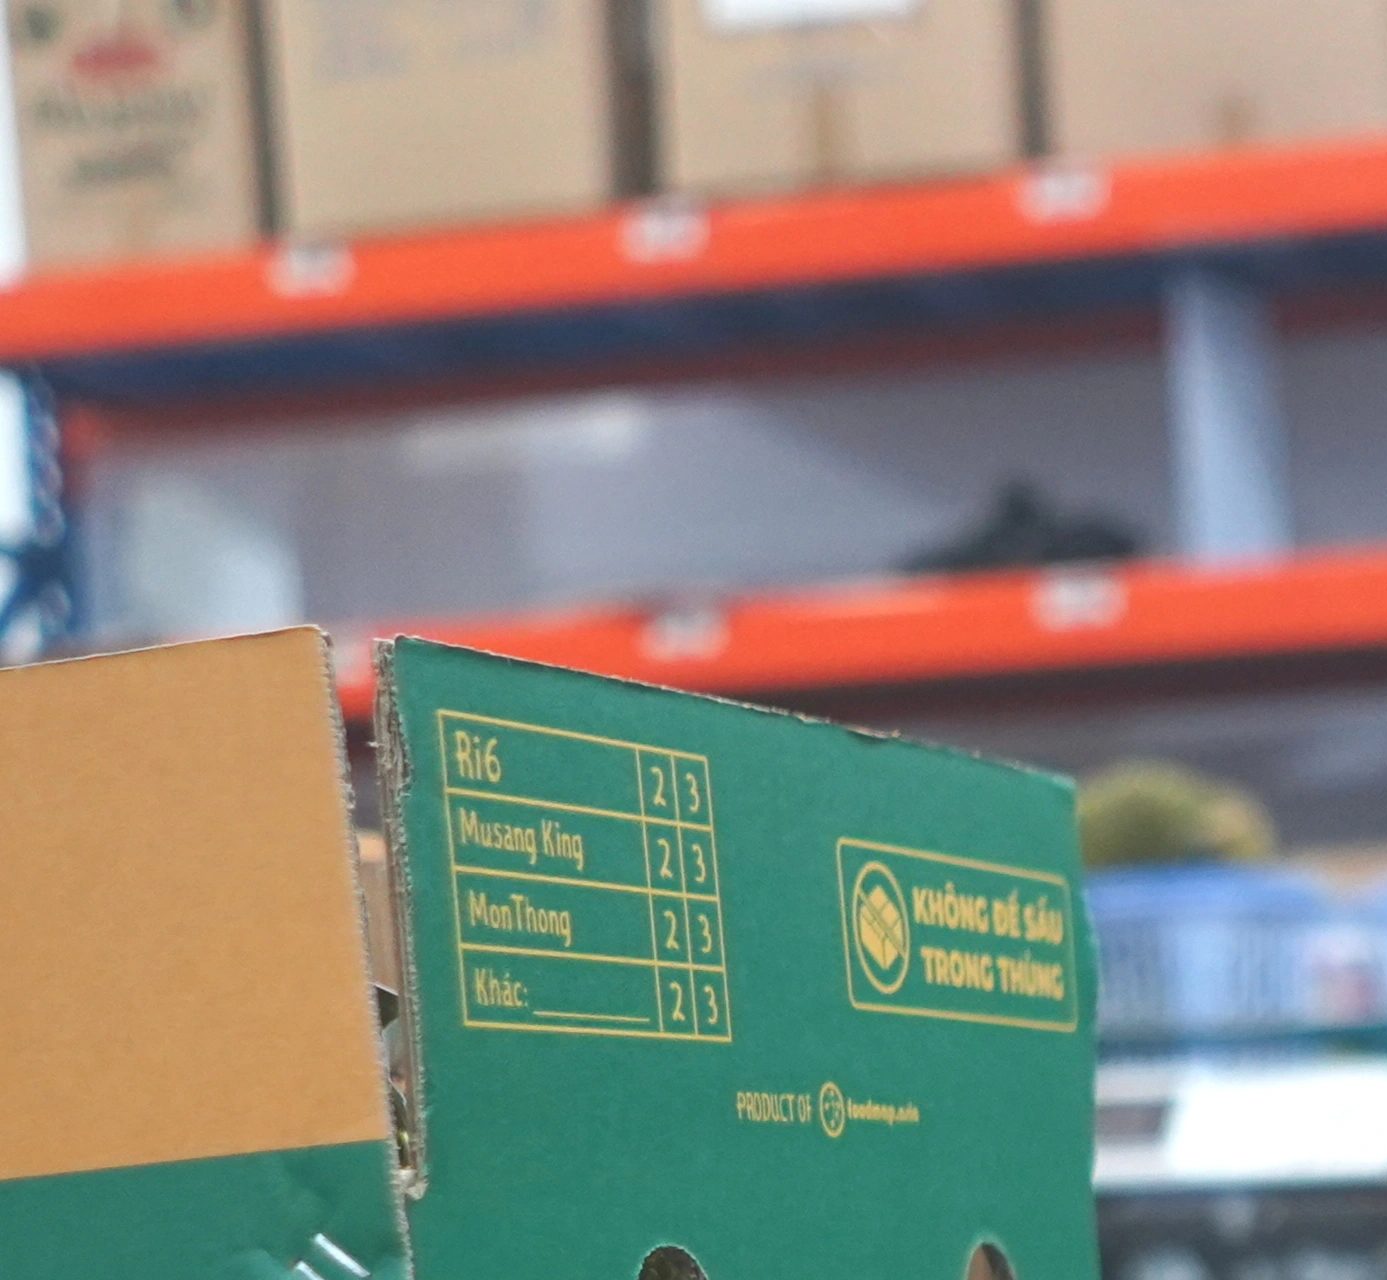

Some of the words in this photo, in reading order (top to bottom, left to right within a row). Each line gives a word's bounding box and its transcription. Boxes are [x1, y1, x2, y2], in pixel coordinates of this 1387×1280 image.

[455, 731, 501, 782] Ri6
[651, 767, 666, 806] 2
[686, 773, 700, 812] 3
[459, 807, 537, 865] Musang
[541, 819, 584, 870] King
[657, 838, 673, 878] 2
[692, 844, 706, 882] 3
[468, 889, 572, 947] MonThong
[912, 881, 989, 934] KHÔNG
[664, 910, 680, 950] 2
[698, 915, 712, 953] 3
[921, 946, 994, 992] TRONG
[670, 982, 686, 1020] 2
[704, 986, 718, 1024] 3
[736, 1091, 795, 1122] PRODUCT
[798, 1094, 812, 1122] OF
